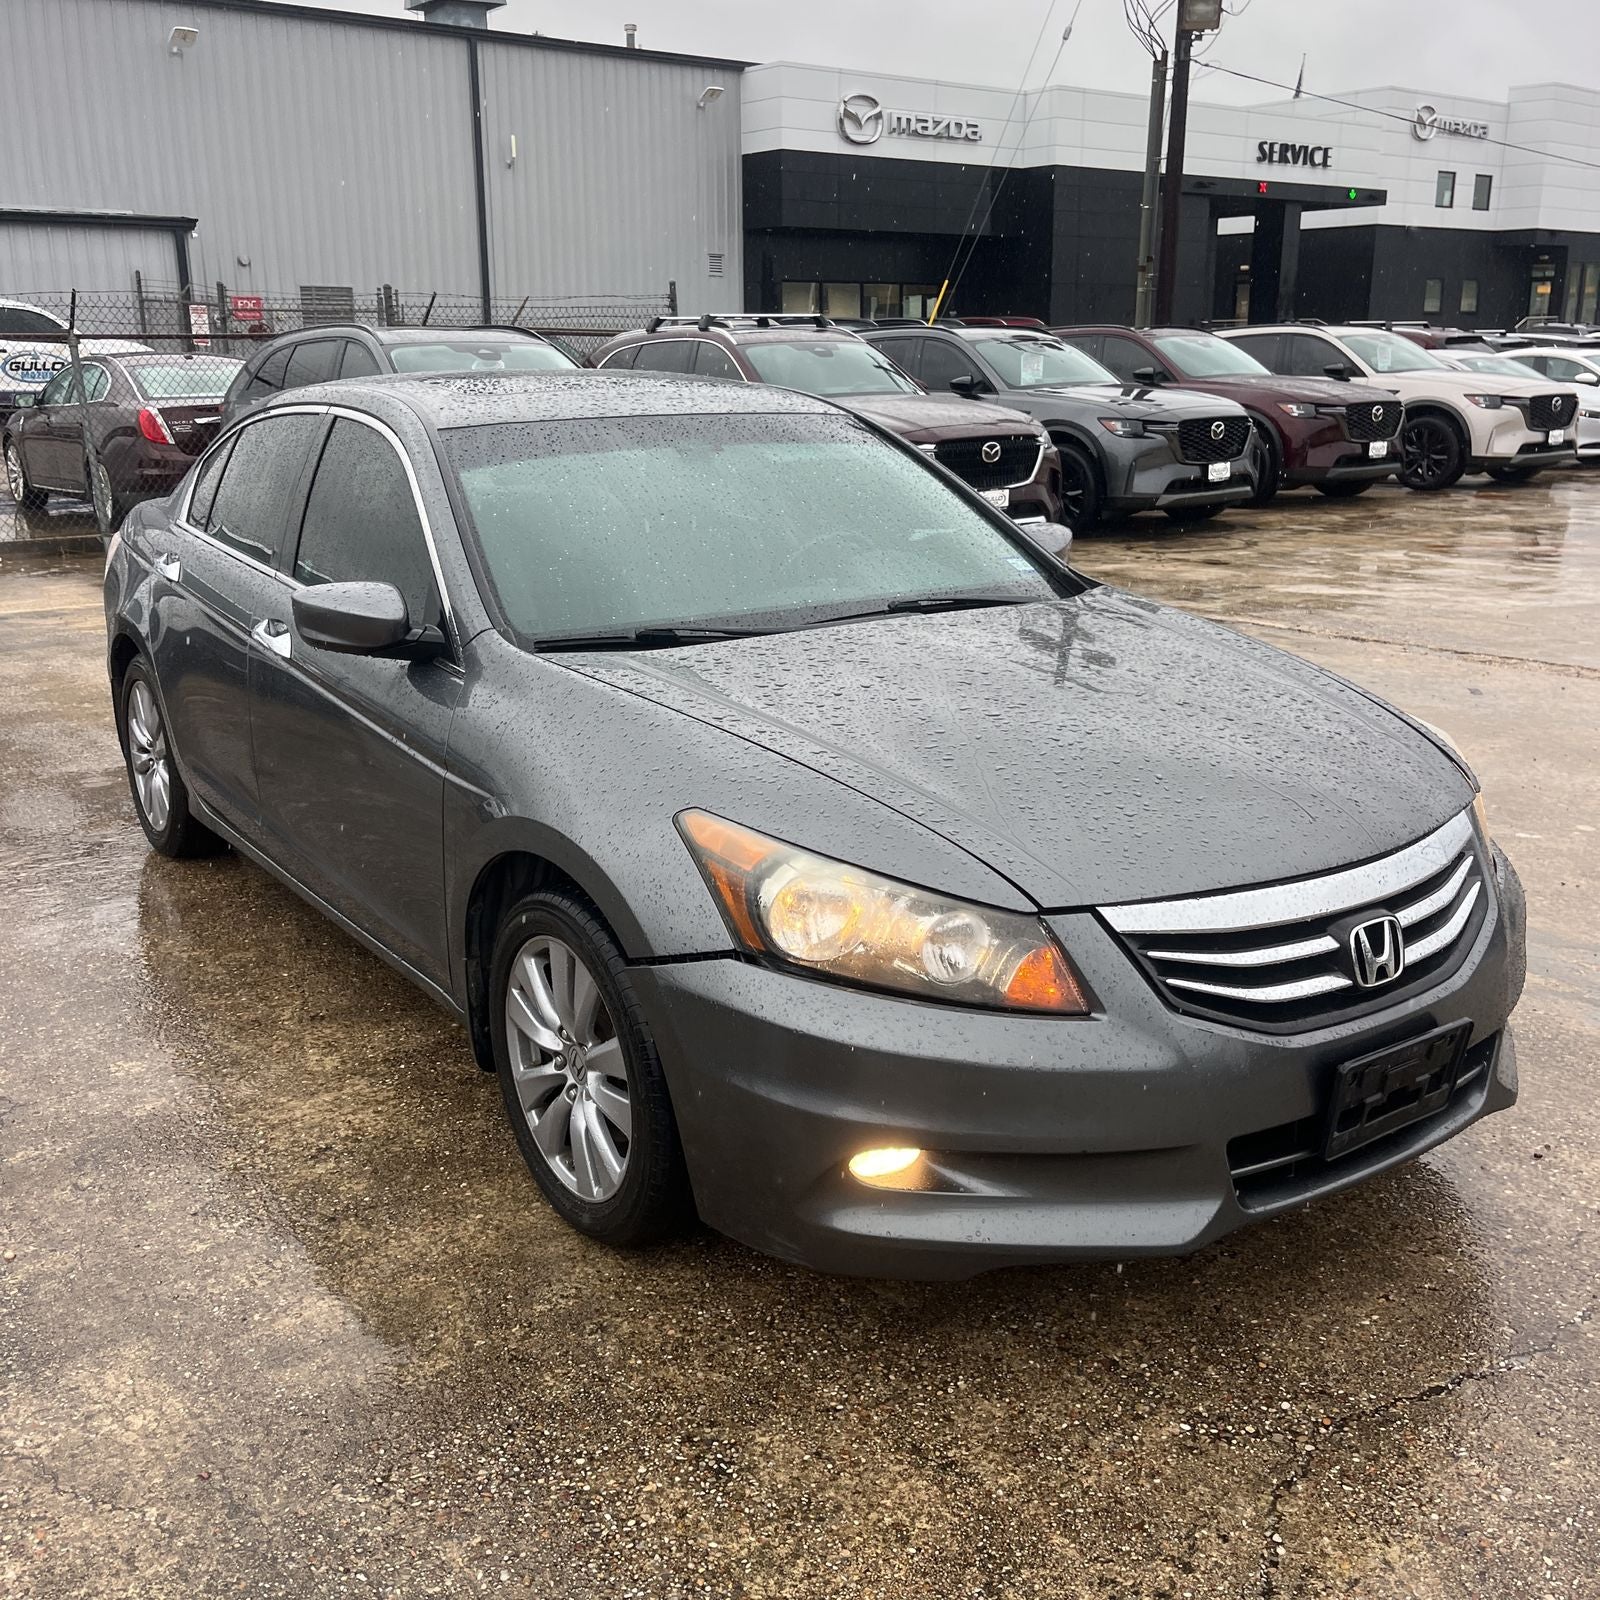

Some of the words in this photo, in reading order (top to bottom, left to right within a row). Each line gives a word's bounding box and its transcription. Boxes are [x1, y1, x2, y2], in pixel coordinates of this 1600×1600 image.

[888, 111, 982, 141] mazda
[1256, 140, 1333, 168] SERVICE
[9, 361, 65, 371] GULLO
